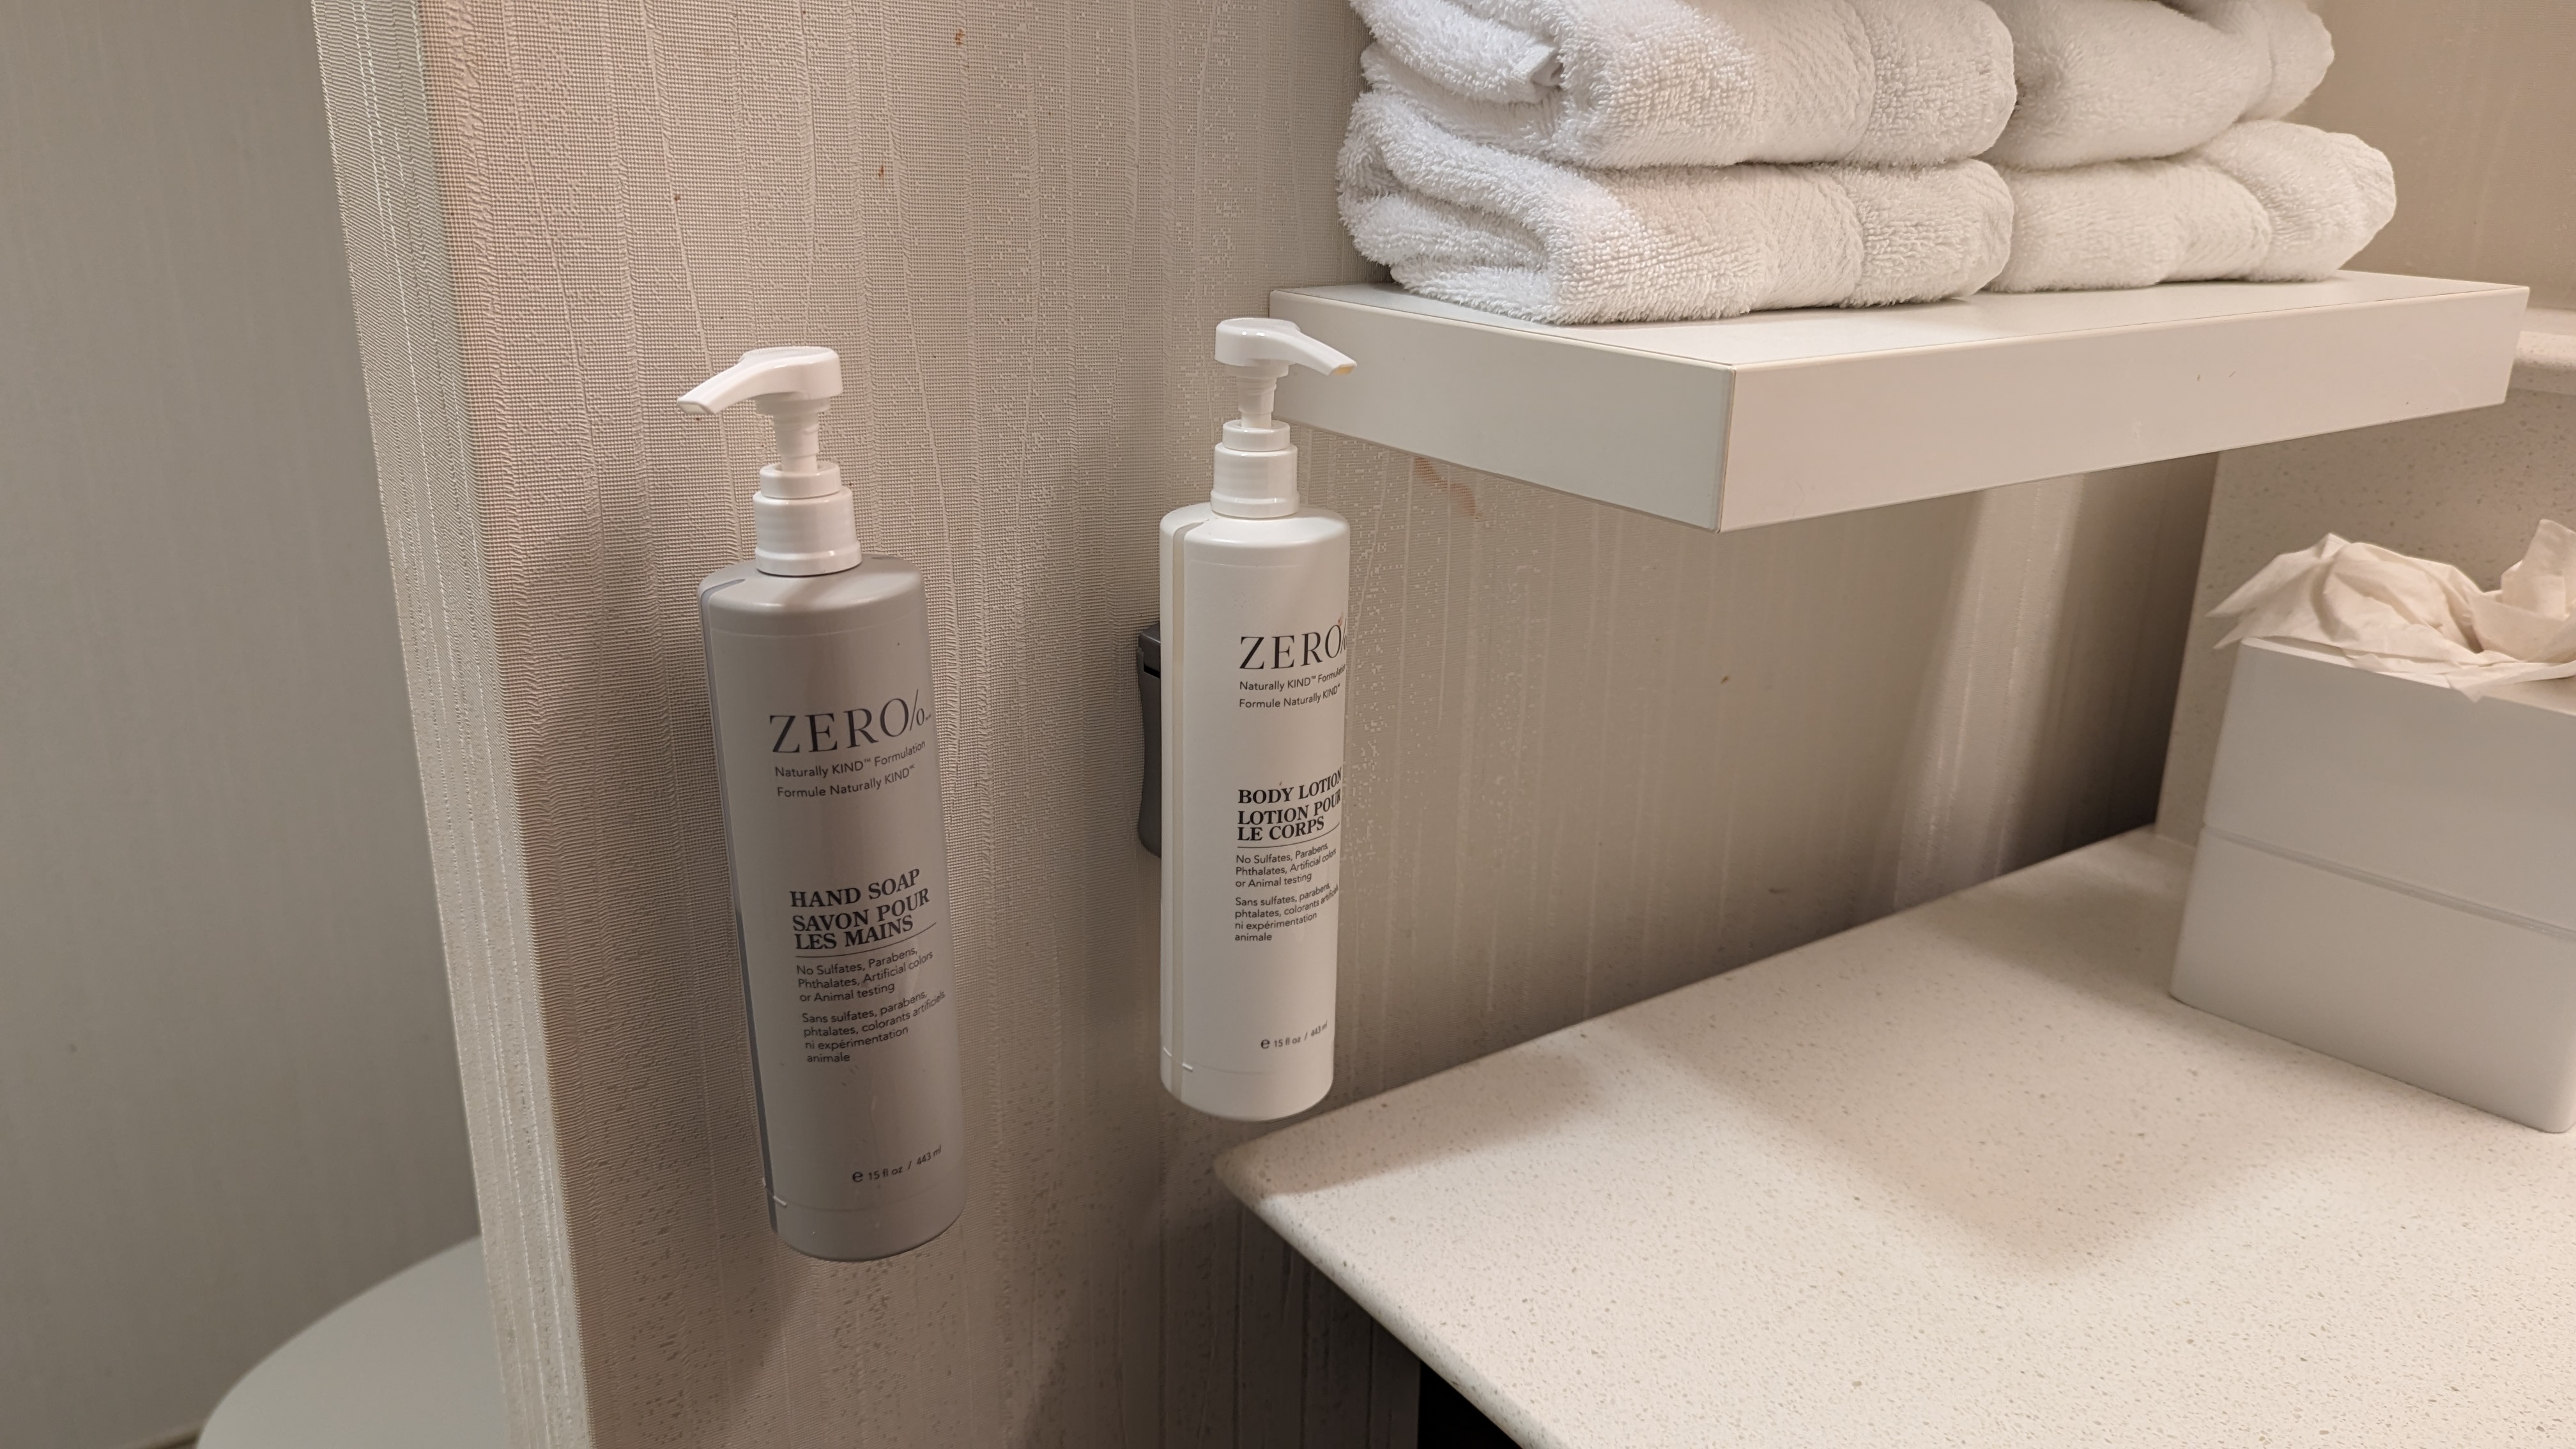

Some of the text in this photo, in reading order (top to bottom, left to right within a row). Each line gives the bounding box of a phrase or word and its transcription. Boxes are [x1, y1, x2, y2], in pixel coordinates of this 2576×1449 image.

[1239, 680, 1285, 693] Naturally
[1239, 698, 1281, 708] Formule
[1284, 692, 1321, 707] Naturally
[775, 766, 828, 779] Naturally
[873, 740, 926, 767] Formulation
[777, 787, 826, 798] Formule
[830, 778, 882, 796] Naturally
[1238, 767, 1342, 804] BODY LOTION
[1238, 788, 1342, 825] LOTION POUR
[1237, 816, 1324, 841] LE CORPS
[1236, 843, 1329, 864] No Sulfates, Parabens,
[1236, 866, 1288, 876] Phthalates,
[1289, 855, 1321, 873] Artificial
[790, 868, 920, 907] HAND SOAP
[1248, 877, 1282, 888] Animal
[1284, 873, 1312, 885] testing
[793, 888, 930, 932] SAVON POUR
[1234, 908, 1282, 919] phtalates,
[1284, 900, 1320, 916] colorants
[1235, 897, 1258, 907] Sans
[1261, 895, 1298, 906] sulfates,
[795, 915, 914, 950] LES MAINS
[1234, 912, 1317, 931] ni expérimentation
[1234, 933, 1273, 942] animale
[797, 947, 918, 976] No Sulfates, Parabens,
[798, 951, 934, 989] Phthalates, Artificial colors
[813, 990, 854, 1002] Animal
[857, 983, 895, 998] testing
[802, 991, 928, 1023] Sans sulfates, parabens,
[803, 1028, 859, 1041] phtalates,
[861, 1013, 911, 1033] colorants
[806, 1026, 909, 1051] ni expérimentation
[1274, 1039, 1284, 1048] 15
[1285, 1037, 1291, 1046] fl
[1292, 1036, 1301, 1045] oz
[807, 1053, 851, 1063] animale
[868, 1170, 880, 1181] 15
[882, 1168, 889, 1177] fl
[891, 1166, 903, 1176] oz
[916, 1152, 931, 1166] 443
[933, 1145, 942, 1157] ml
